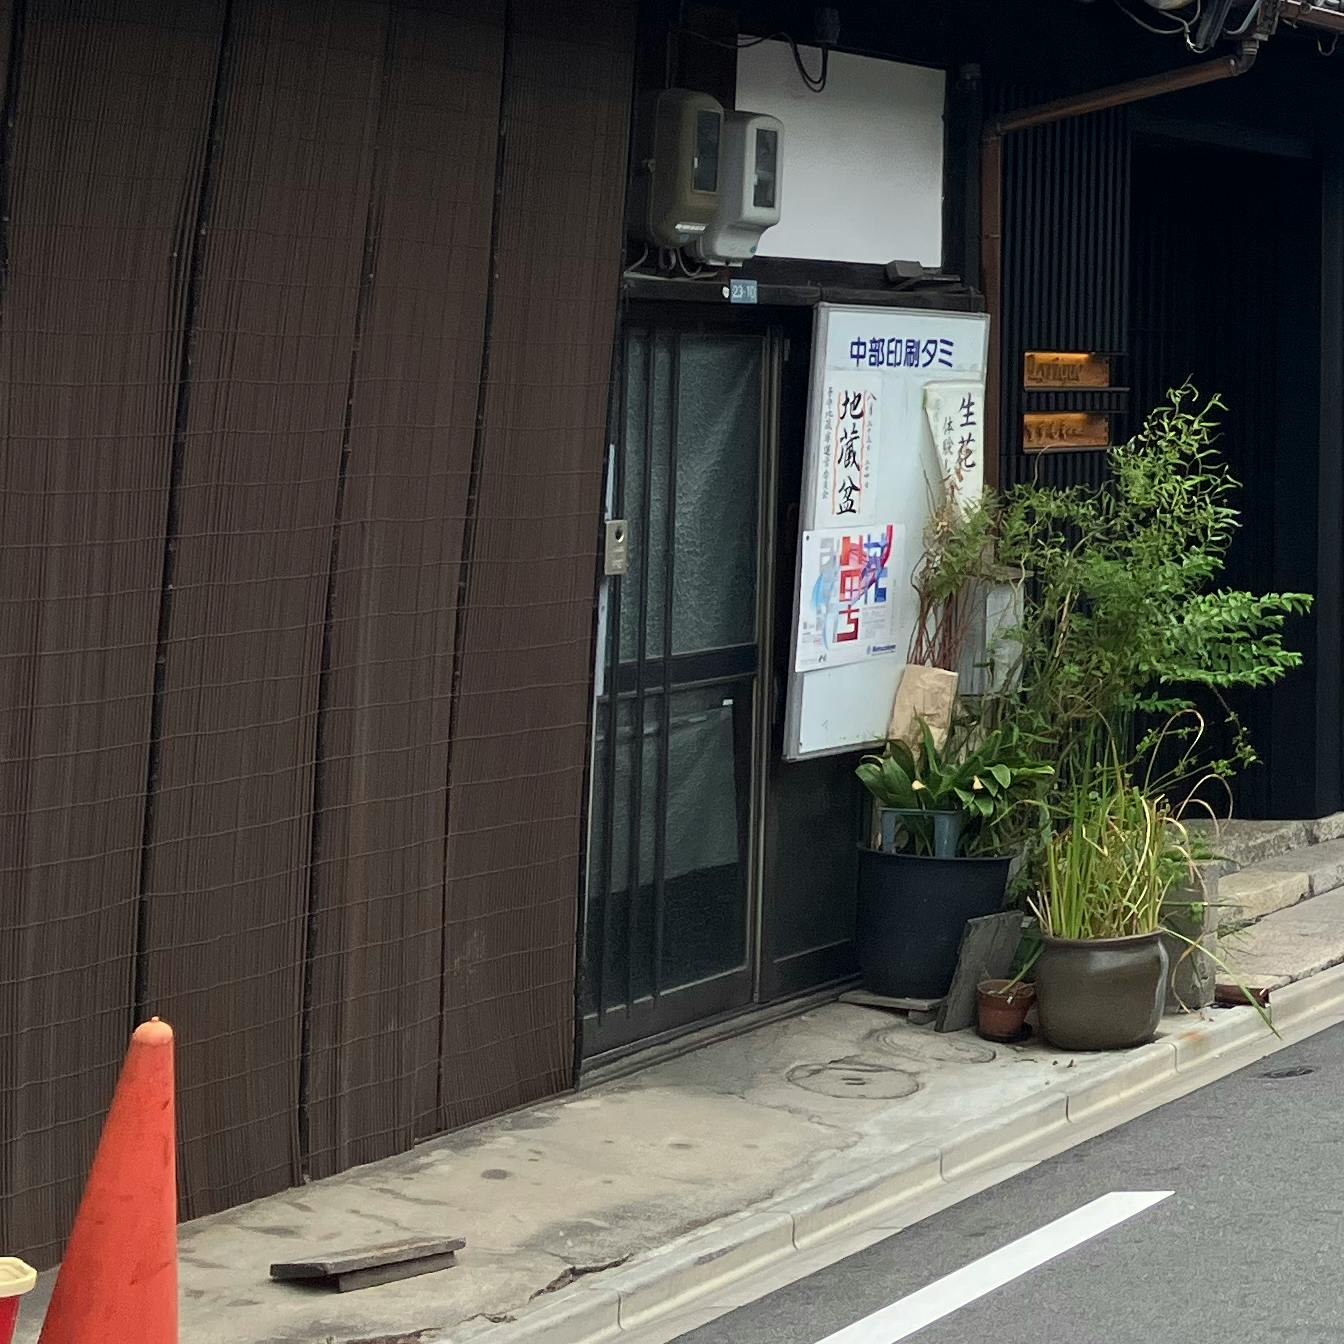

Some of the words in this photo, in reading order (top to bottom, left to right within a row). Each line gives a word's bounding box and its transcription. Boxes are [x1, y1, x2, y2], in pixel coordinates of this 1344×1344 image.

[850, 336, 955, 368] 中部印刷タミ
[836, 390, 866, 516] 地蔵盆
[958, 392, 977, 469] 生花
